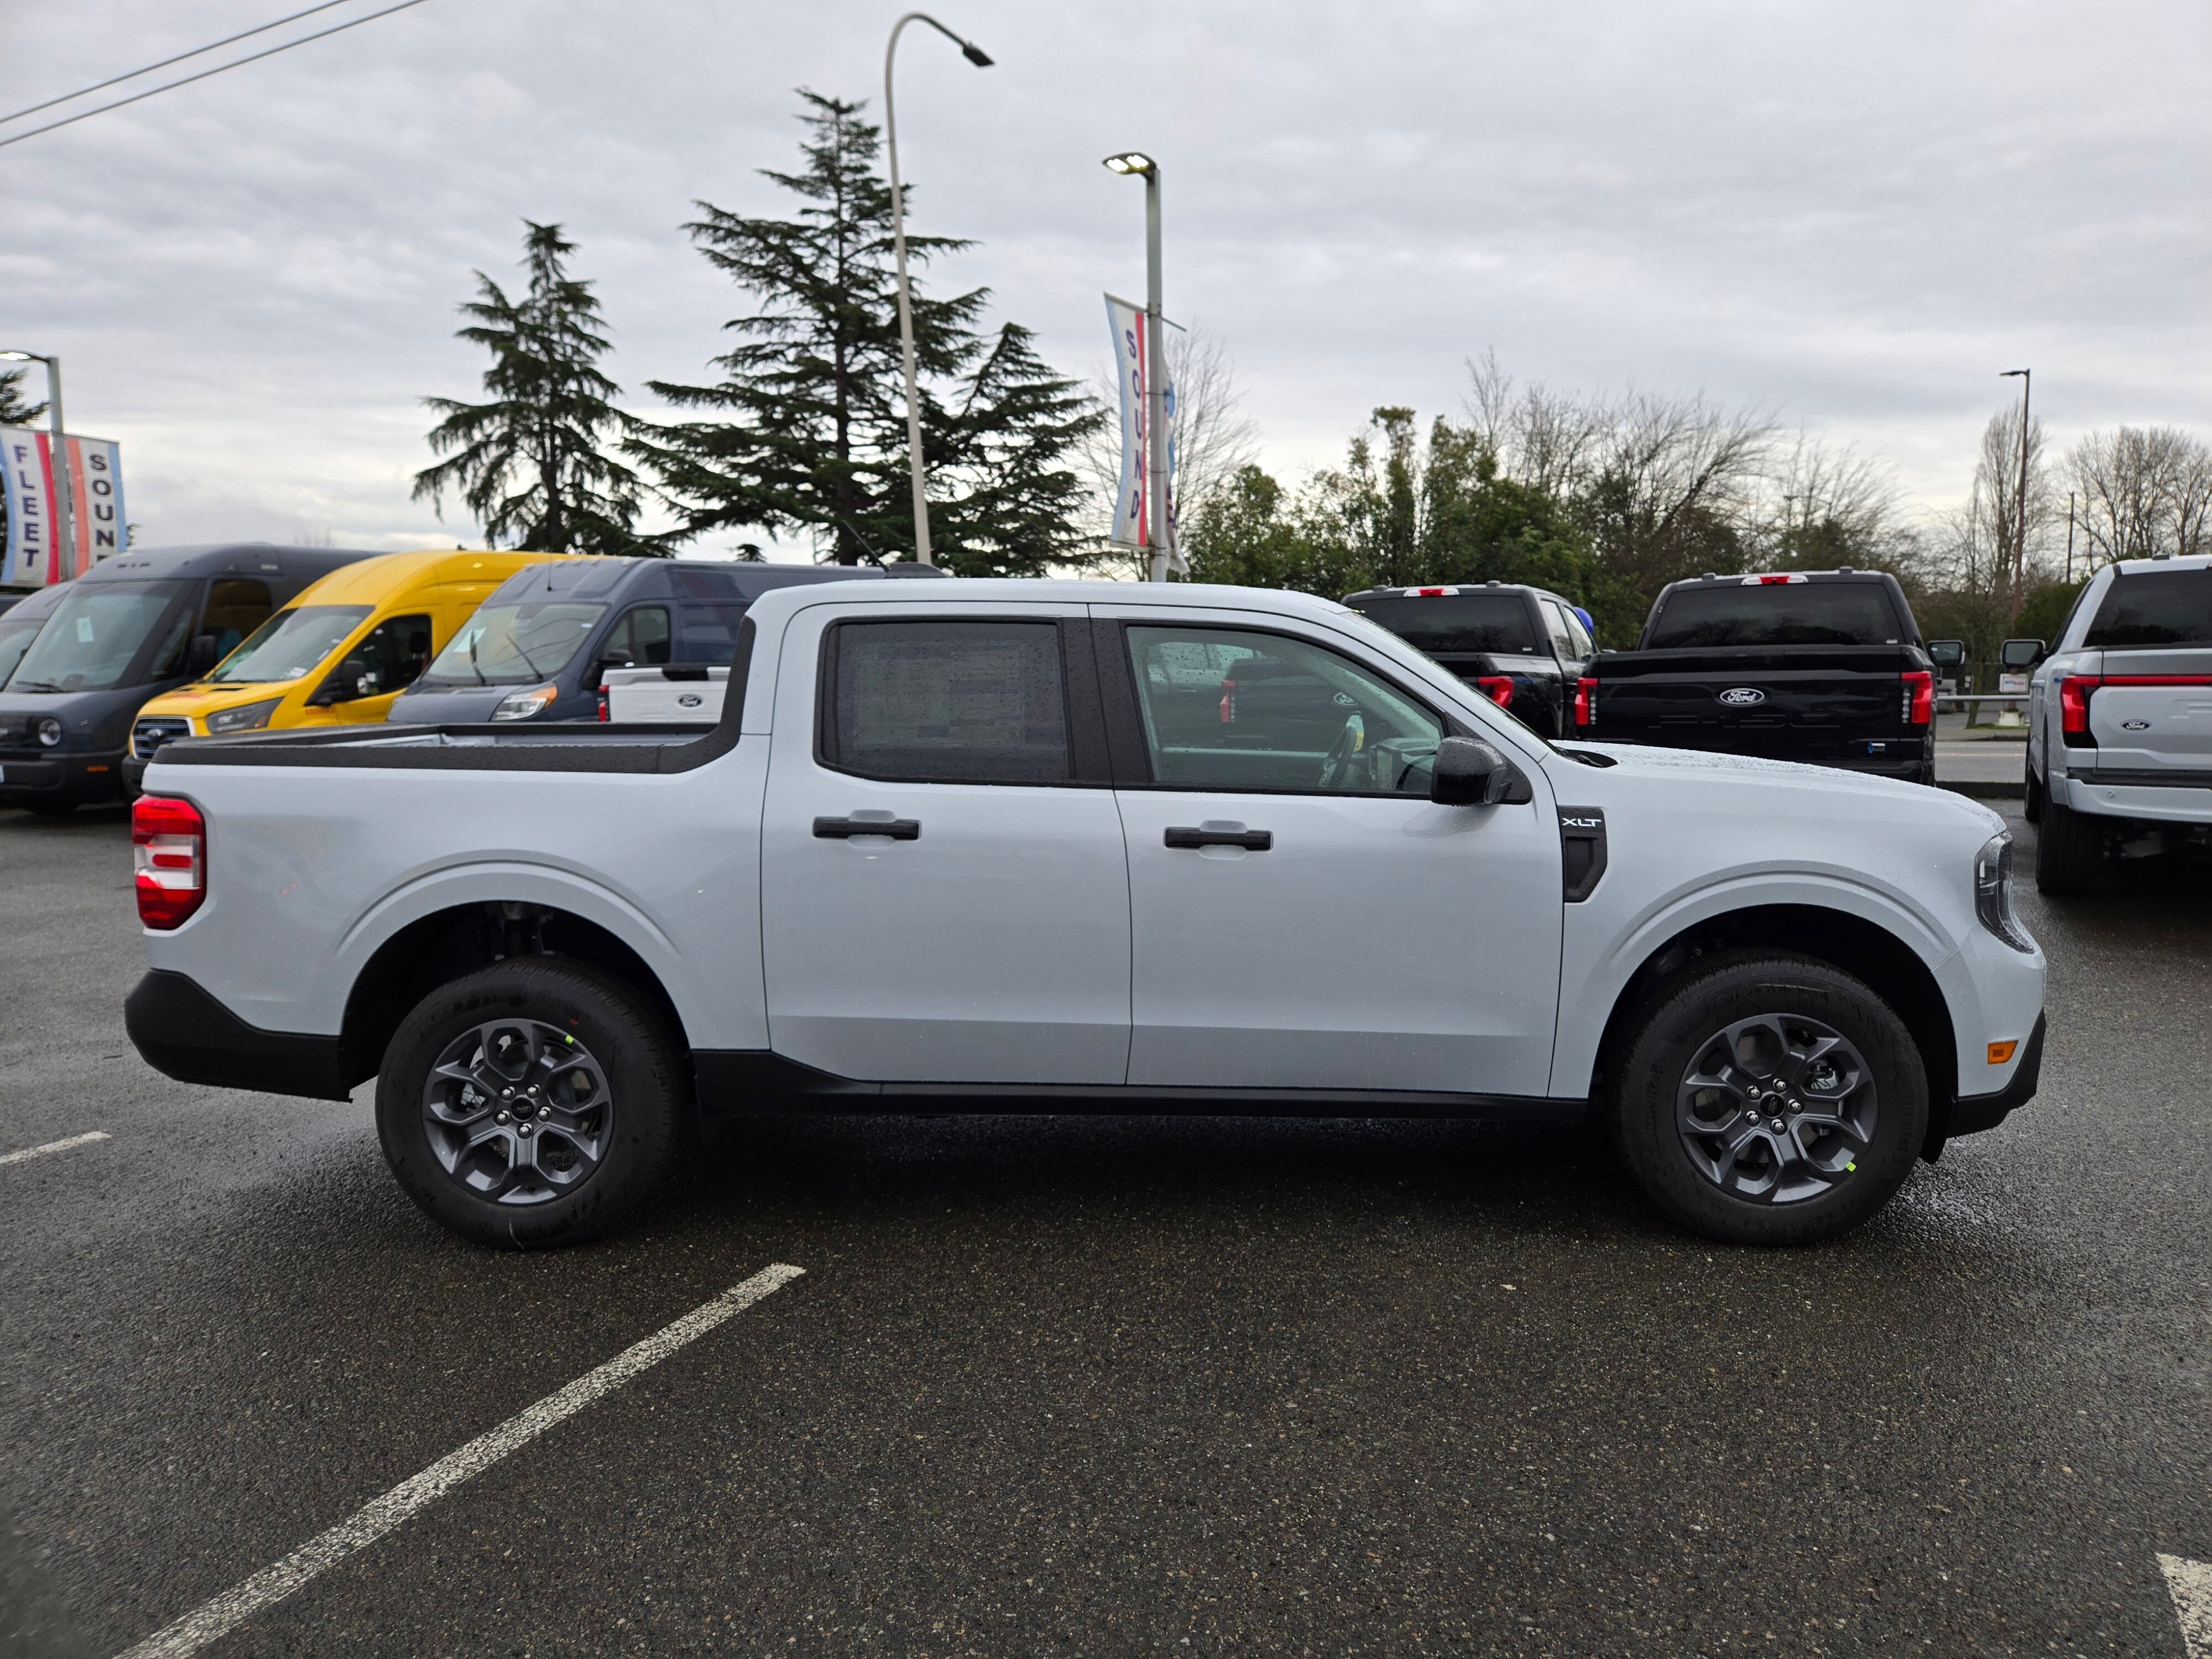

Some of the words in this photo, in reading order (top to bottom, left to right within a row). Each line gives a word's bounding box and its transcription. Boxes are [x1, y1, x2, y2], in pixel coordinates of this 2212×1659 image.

[1125, 328, 1142, 519] SOUND
[13, 444, 39, 567] FLEET
[89, 454, 114, 561] SOUN
[1726, 690, 1757, 702] Ford
[2125, 720, 2146, 729] Ford
[1562, 817, 1602, 827] XLT
